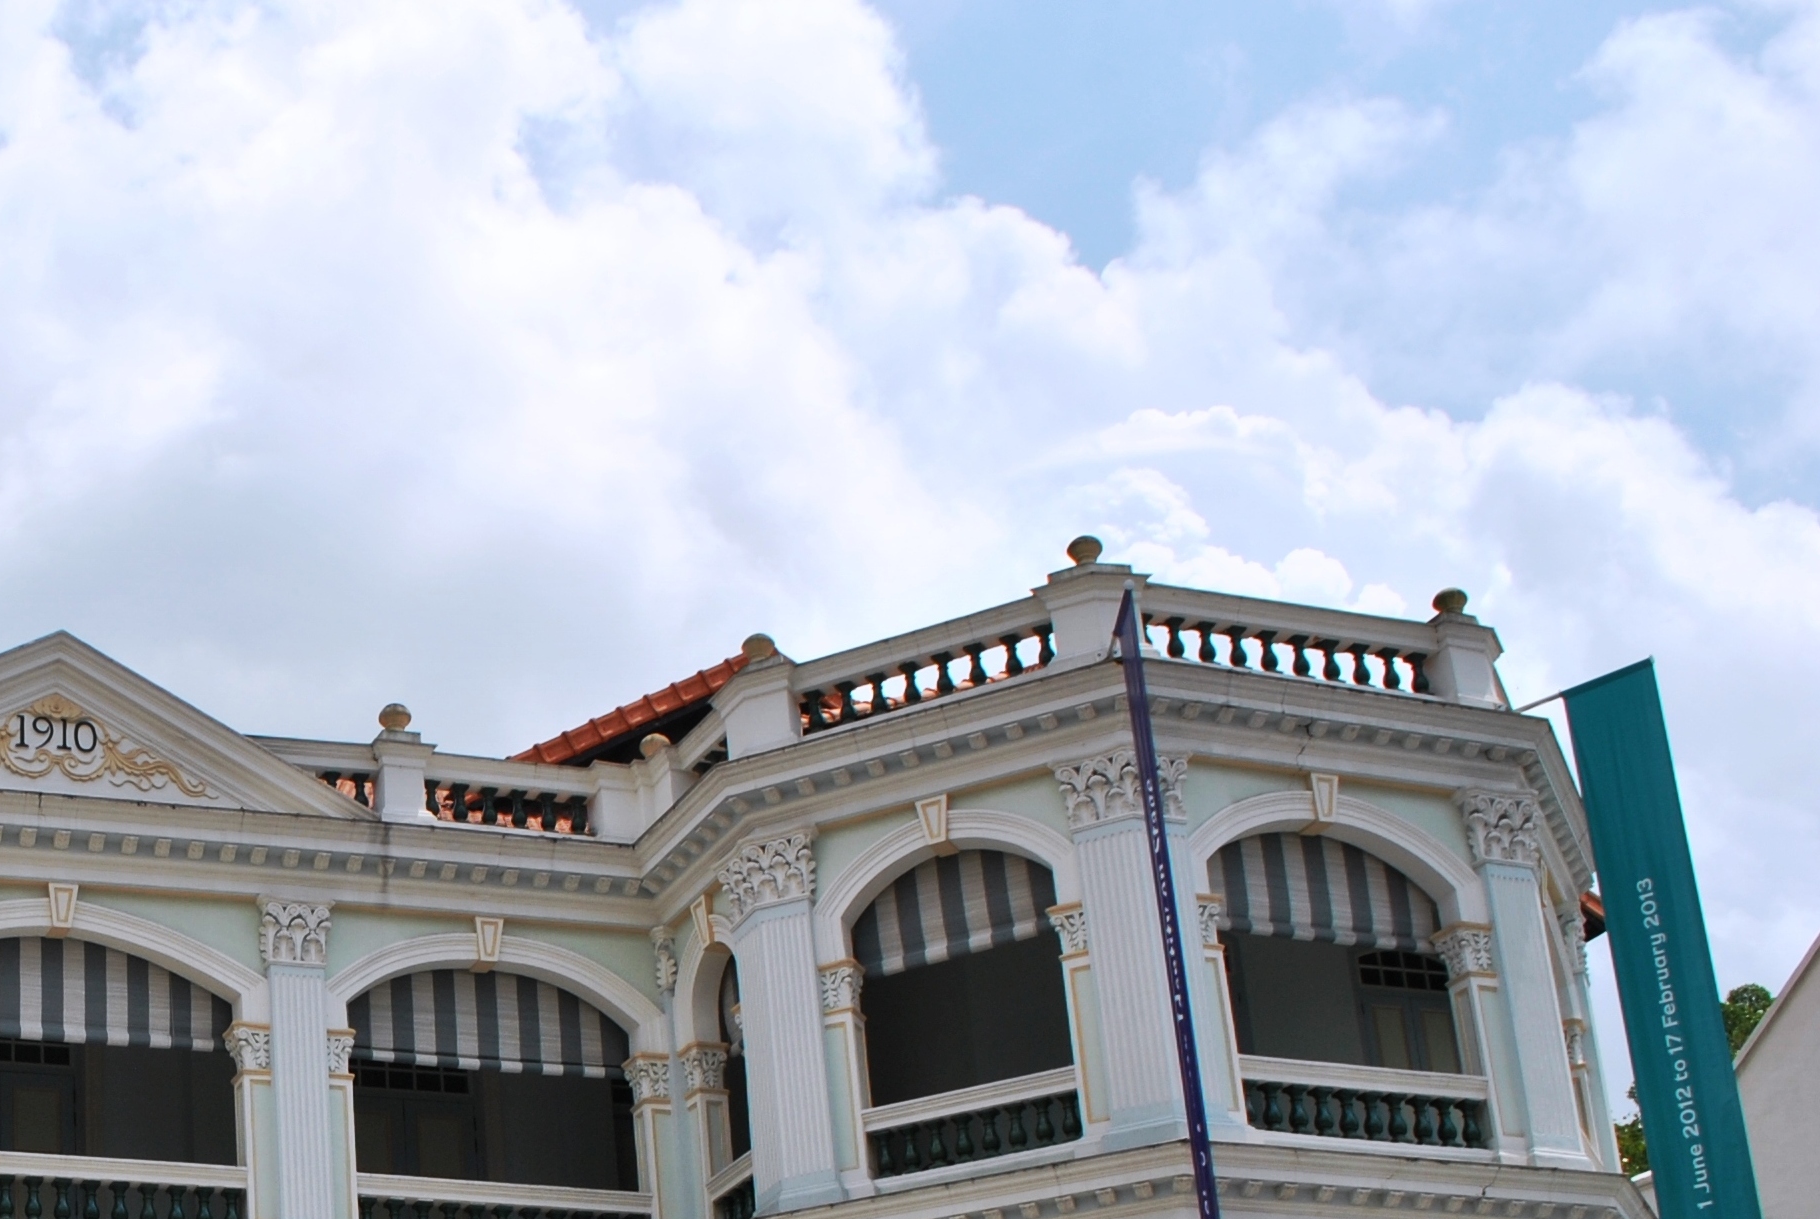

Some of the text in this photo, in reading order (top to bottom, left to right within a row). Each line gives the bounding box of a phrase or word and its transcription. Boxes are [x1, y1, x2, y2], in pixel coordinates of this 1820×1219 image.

[15, 714, 98, 753] 1910
[1636, 877, 1713, 1210] 1 June 2012 to 17 February 2013
